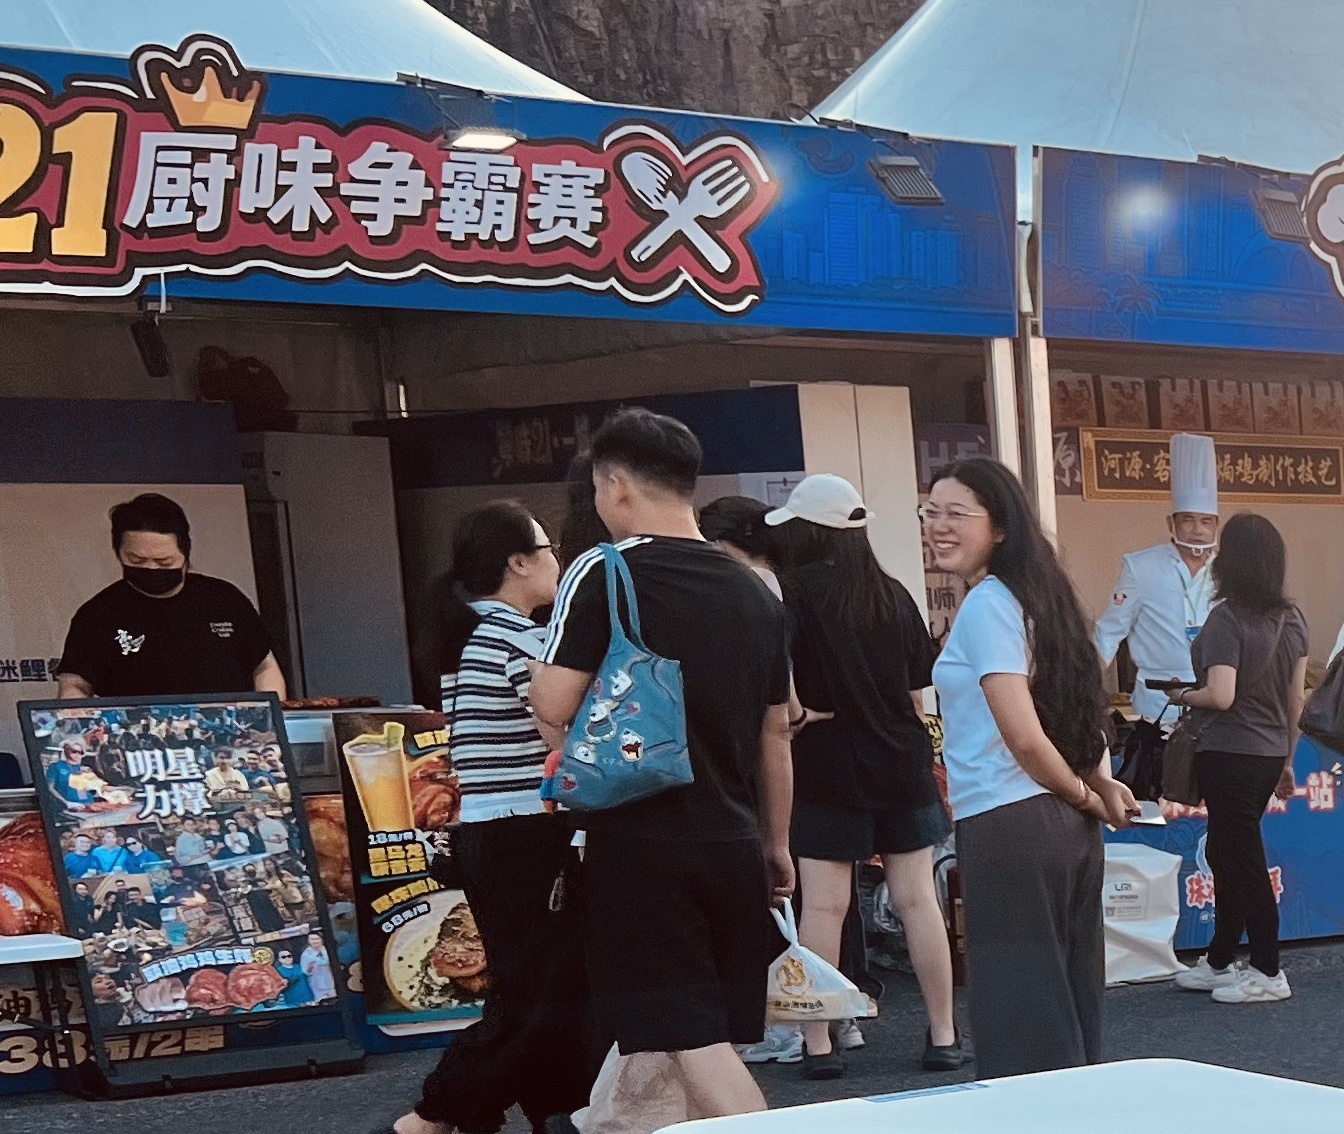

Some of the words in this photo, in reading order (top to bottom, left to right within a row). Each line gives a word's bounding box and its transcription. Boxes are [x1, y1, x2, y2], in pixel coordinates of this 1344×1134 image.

[1101, 448, 1338, 488] 河源·客焗鸡制作技艺
[125, 746, 204, 783] 明星
